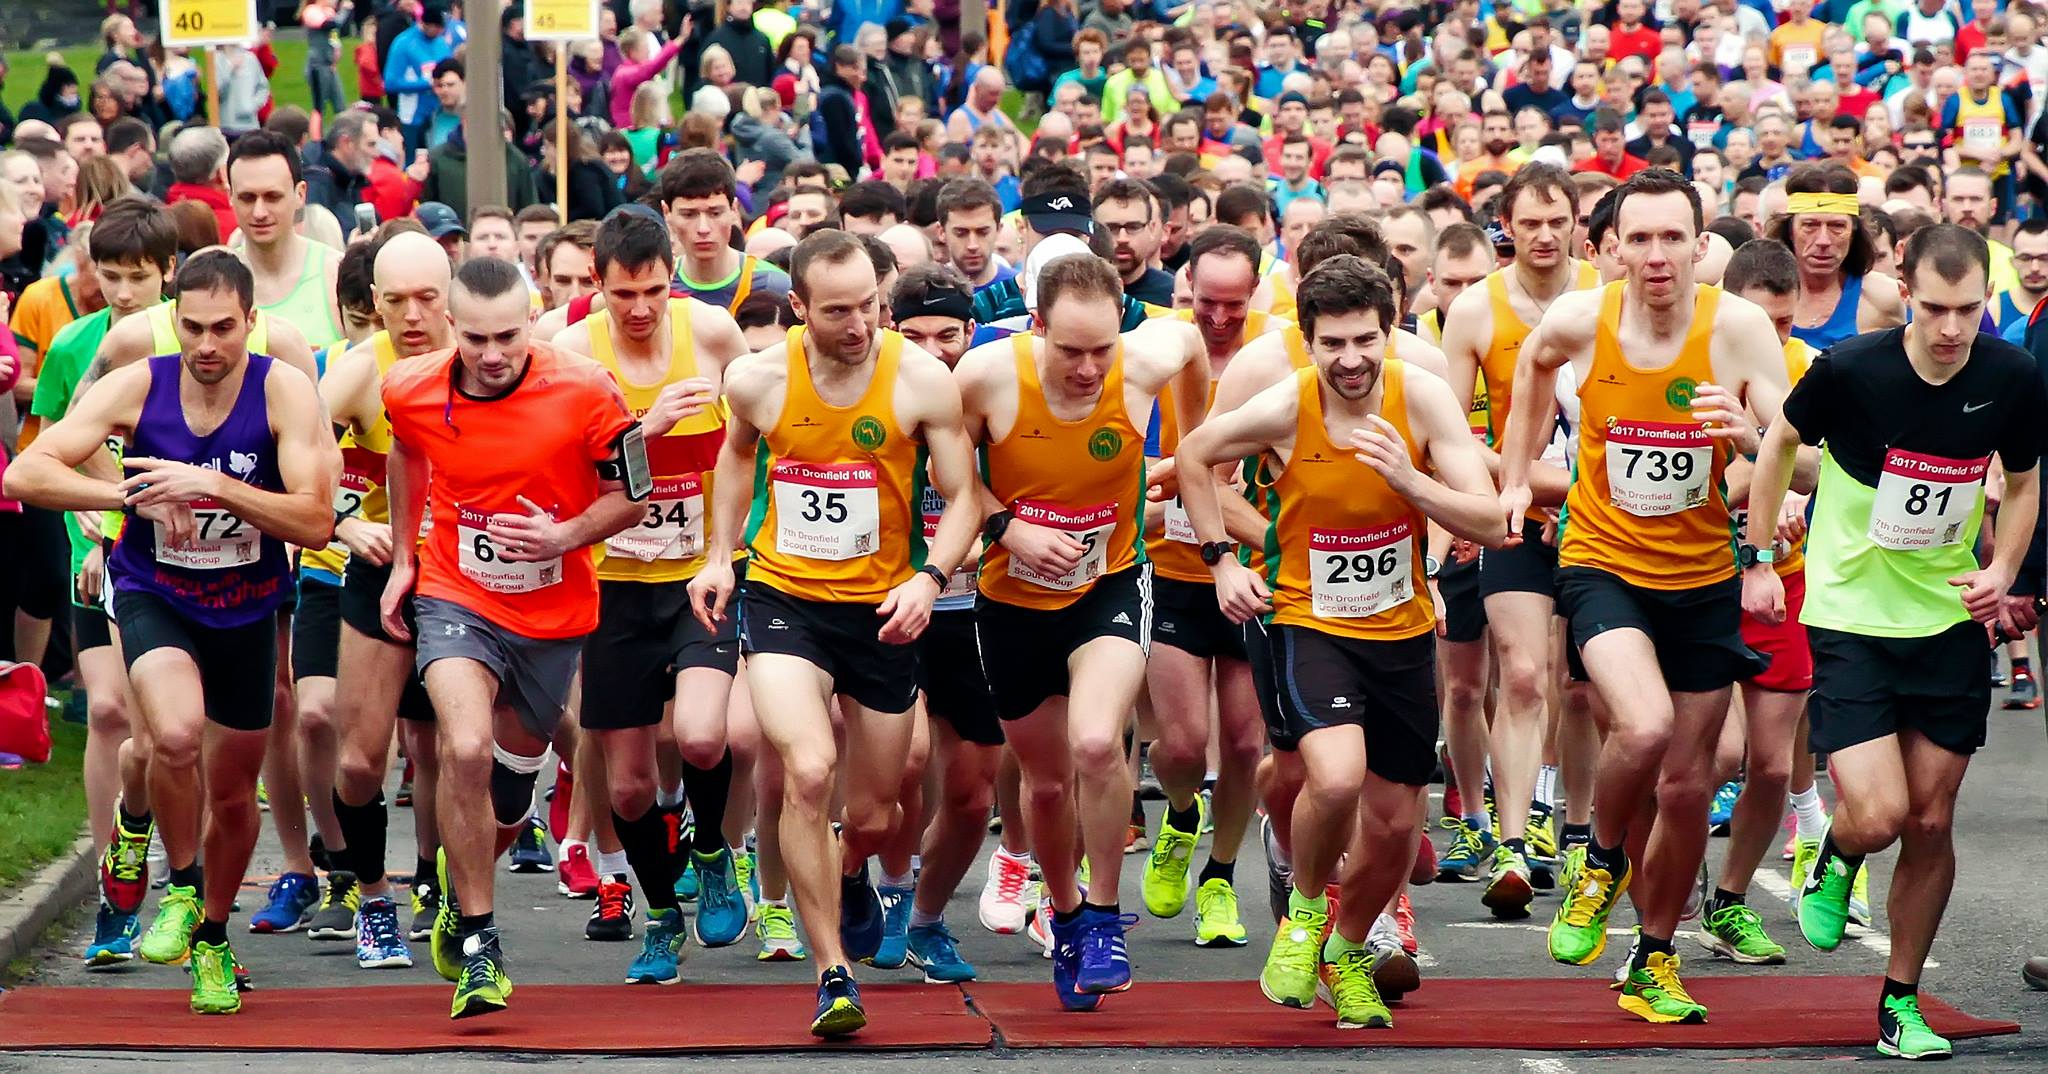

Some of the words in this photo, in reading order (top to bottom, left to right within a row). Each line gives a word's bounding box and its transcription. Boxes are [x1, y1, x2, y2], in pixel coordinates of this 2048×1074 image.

[176, 11, 203, 31] 40
[1610, 426, 1634, 436] 2017
[1637, 429, 1686, 440] Dronfield
[1622, 448, 1694, 481] 739
[1890, 456, 1917, 470] 2017
[1919, 462, 1968, 475] Dronfield
[1970, 466, 1984, 474] 10k
[776, 465, 799, 475] 2017
[802, 468, 850, 480] Dronfield
[852, 470, 872, 480] 10k
[653, 485, 678, 494] nfield
[681, 481, 697, 490] 10k
[1628, 491, 1672, 500] Dronfield
[1905, 484, 1953, 516] 81
[801, 490, 848, 523] 35
[461, 510, 483, 523] 2017
[643, 501, 688, 528] 34
[1020, 506, 1046, 518] 2017
[1048, 511, 1094, 524] Dronfield
[1097, 509, 1113, 519] 10k
[195, 512, 242, 540] 72
[1169, 528, 1192, 538] Scout
[1313, 533, 1337, 544] 2017
[1341, 530, 1389, 544] Dronfield
[1392, 523, 1408, 535] 10k
[1876, 519, 1890, 531] 7th
[1892, 525, 1936, 535] Dronfield
[627, 537, 670, 547] Dronfield
[784, 528, 797, 537] 7th
[798, 532, 840, 543] Dronfield
[1874, 530, 1900, 545] Scout
[1902, 537, 1931, 545] Group
[783, 539, 808, 550] Scout
[809, 545, 839, 555] Group
[190, 556, 220, 564] Group
[1326, 548, 1397, 584] 296
[481, 571, 525, 580] Dronfield
[493, 582, 525, 590] Group
[1318, 593, 1333, 601] 7th
[1336, 591, 1380, 602] Dronfield
